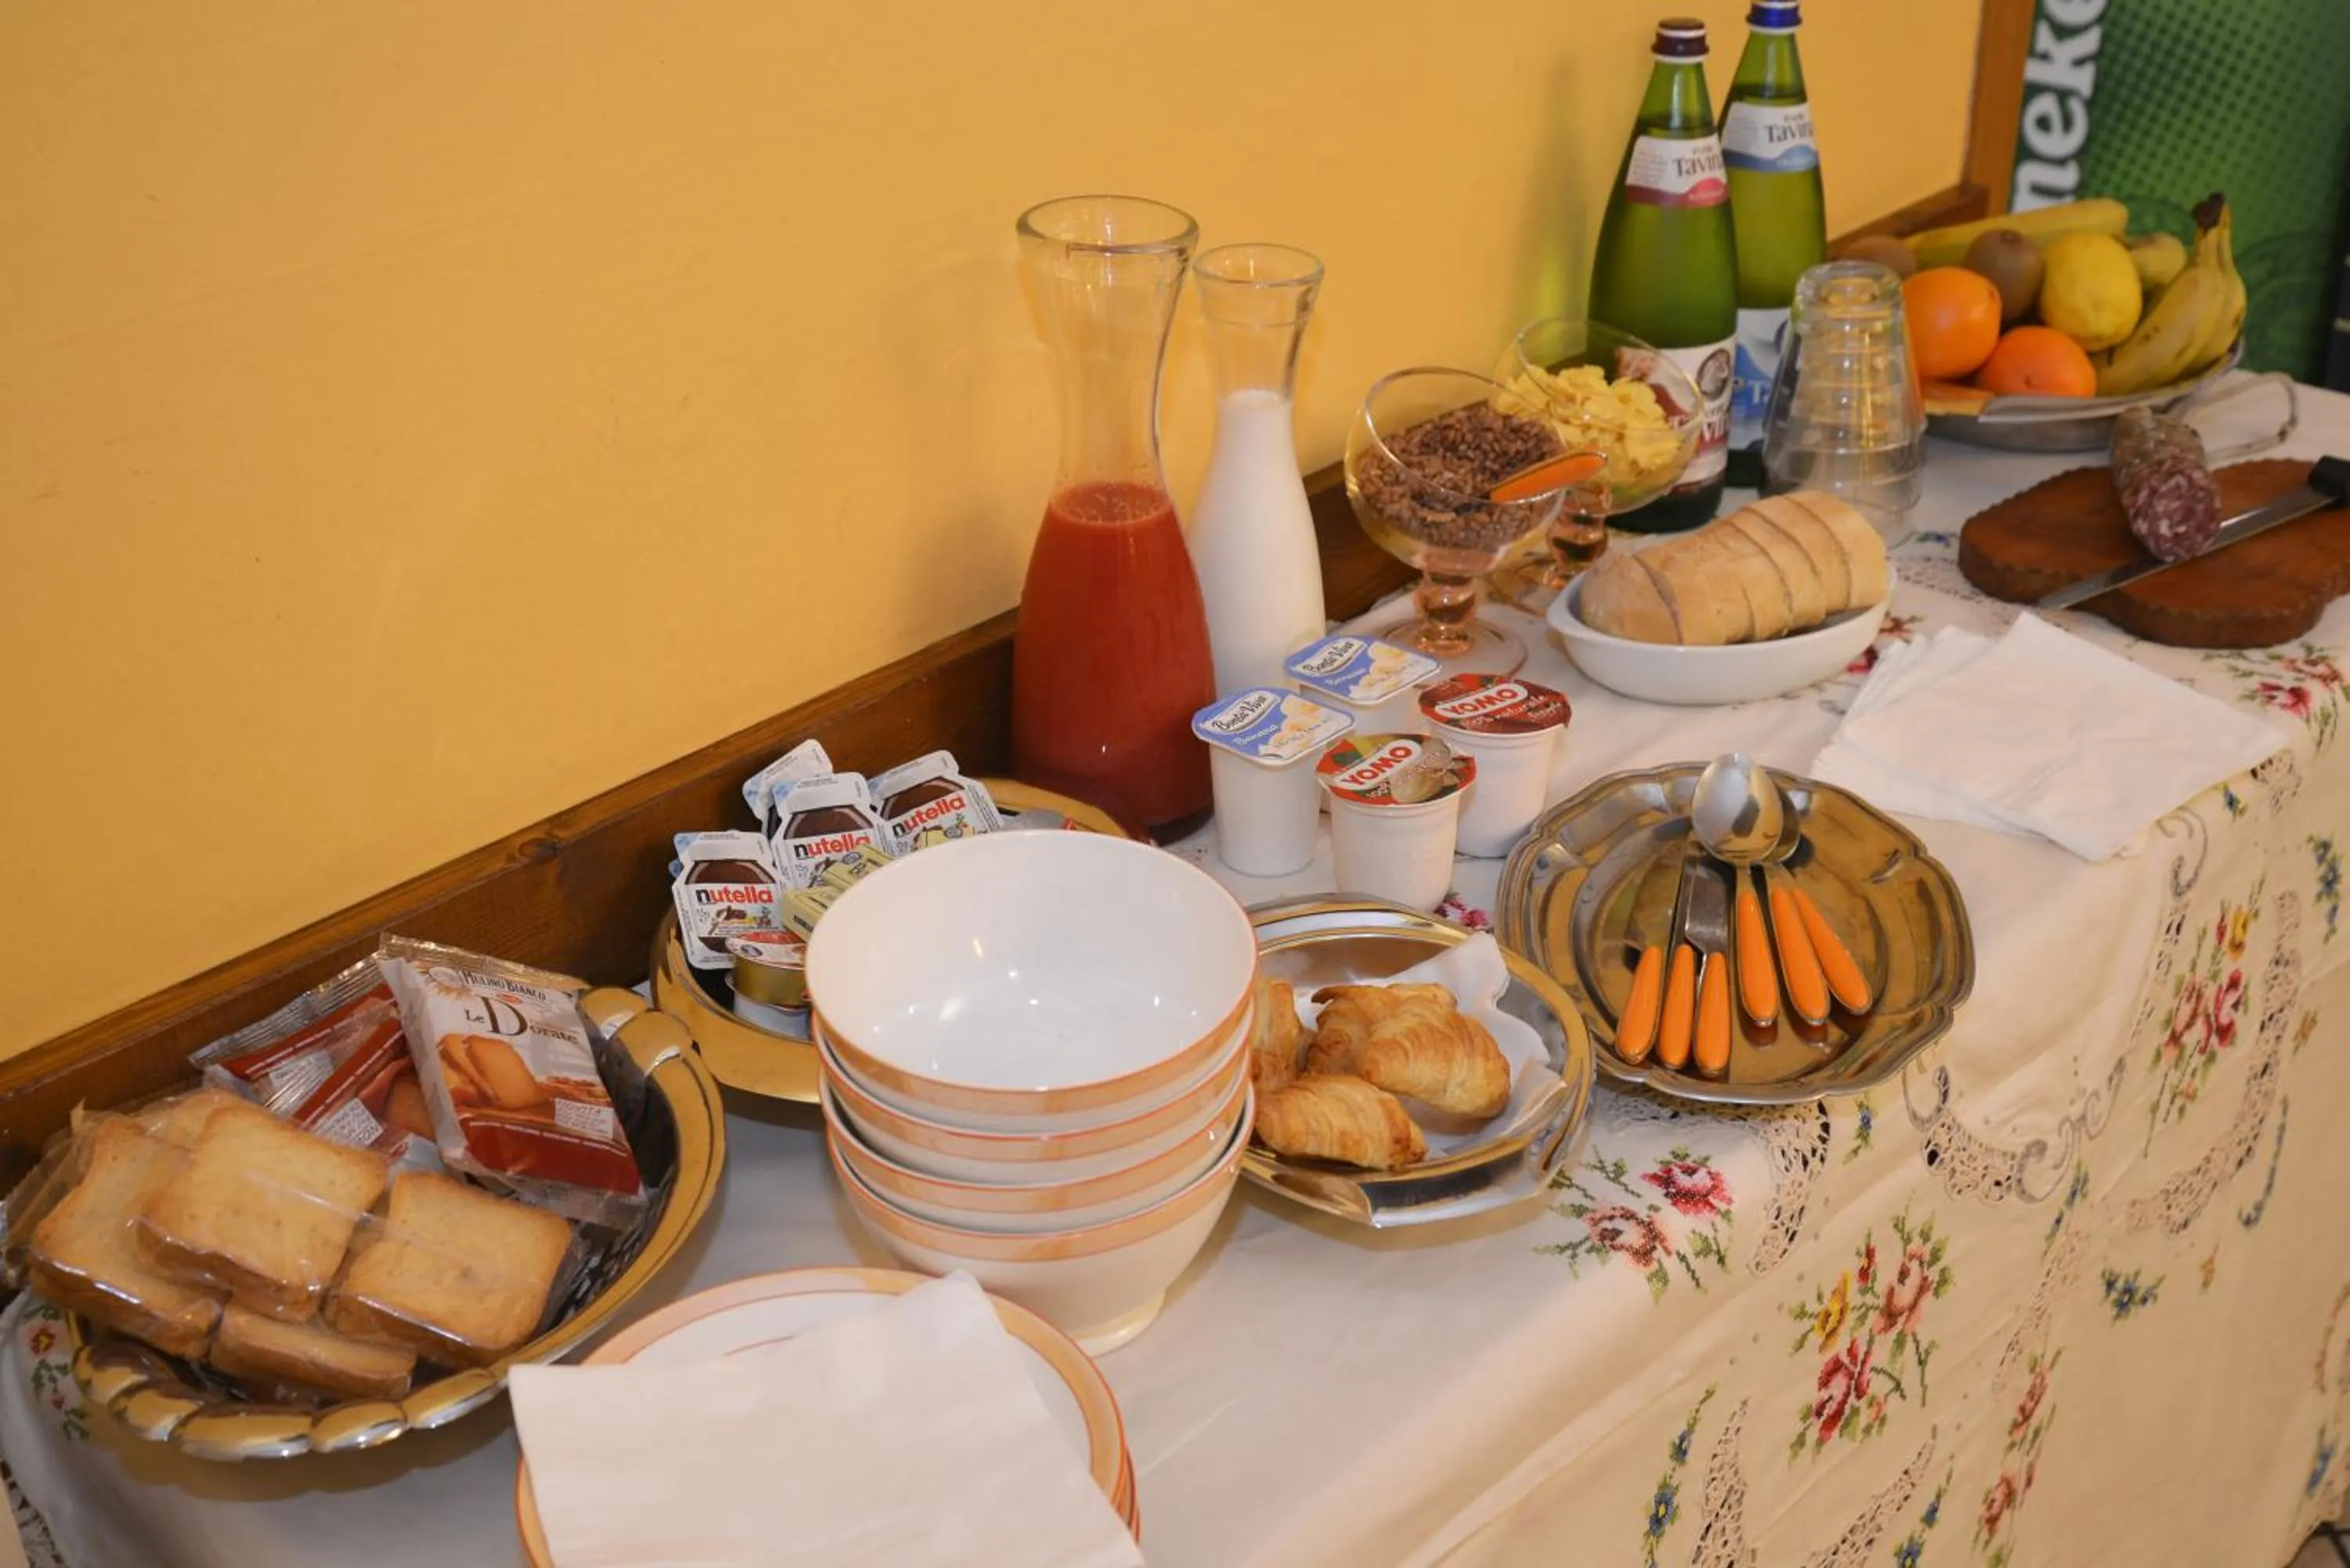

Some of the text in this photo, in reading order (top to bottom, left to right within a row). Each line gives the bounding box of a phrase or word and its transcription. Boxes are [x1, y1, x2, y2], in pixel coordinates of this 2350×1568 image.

[1441, 688, 1518, 714] YOMO
[1341, 746, 1413, 786] YOMO
[891, 795, 966, 838] nutella
[696, 885, 774, 904] nutella
[475, 994, 579, 1044] Dorate
